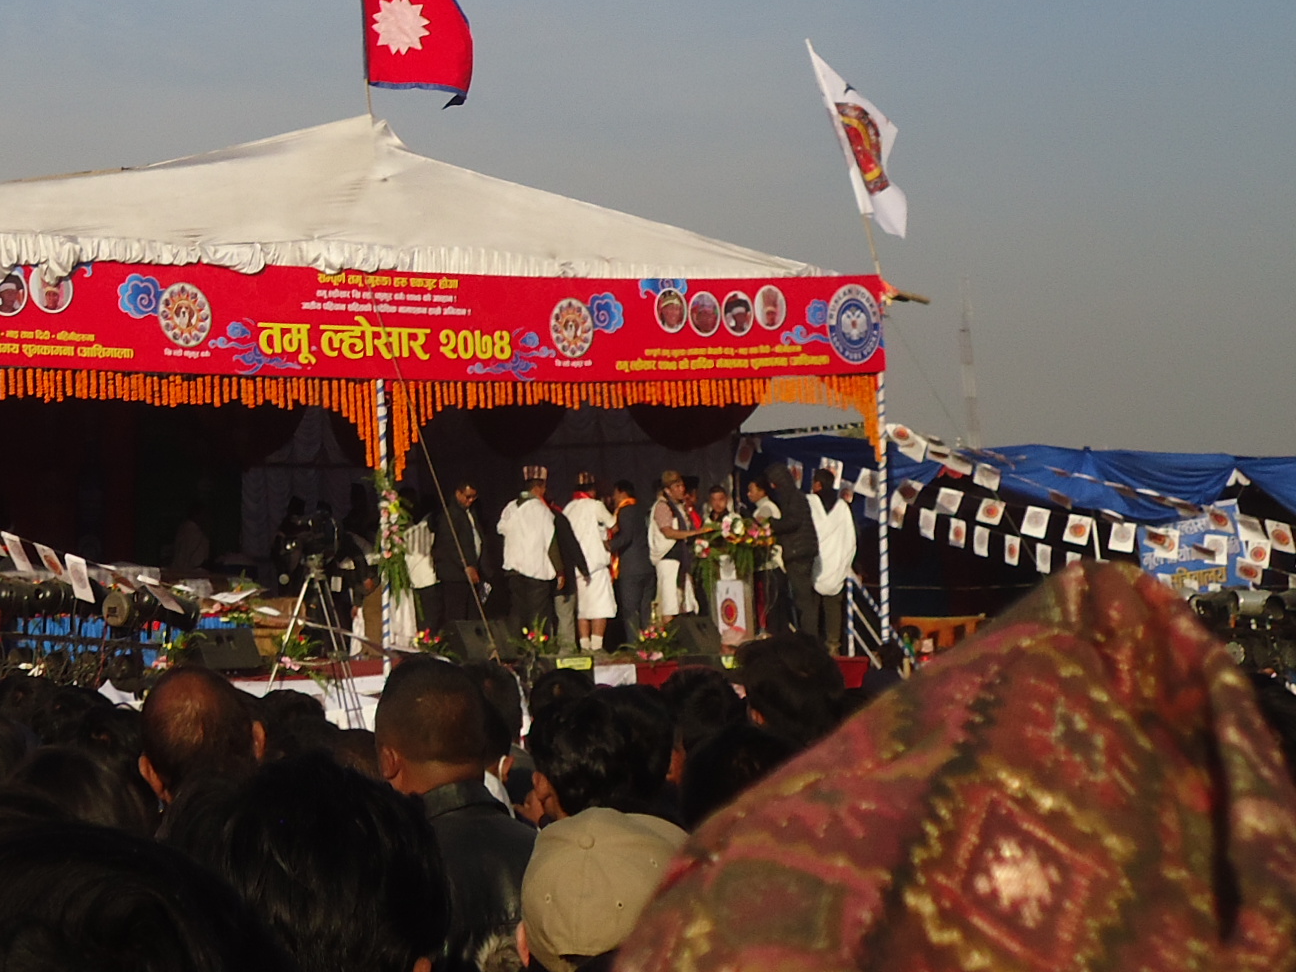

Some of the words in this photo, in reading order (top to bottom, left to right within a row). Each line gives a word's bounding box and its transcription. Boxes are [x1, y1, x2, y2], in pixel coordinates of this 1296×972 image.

[257, 321, 317, 365] तमू
[319, 315, 431, 361] ल्होसार
[438, 328, 512, 361] २०७४
